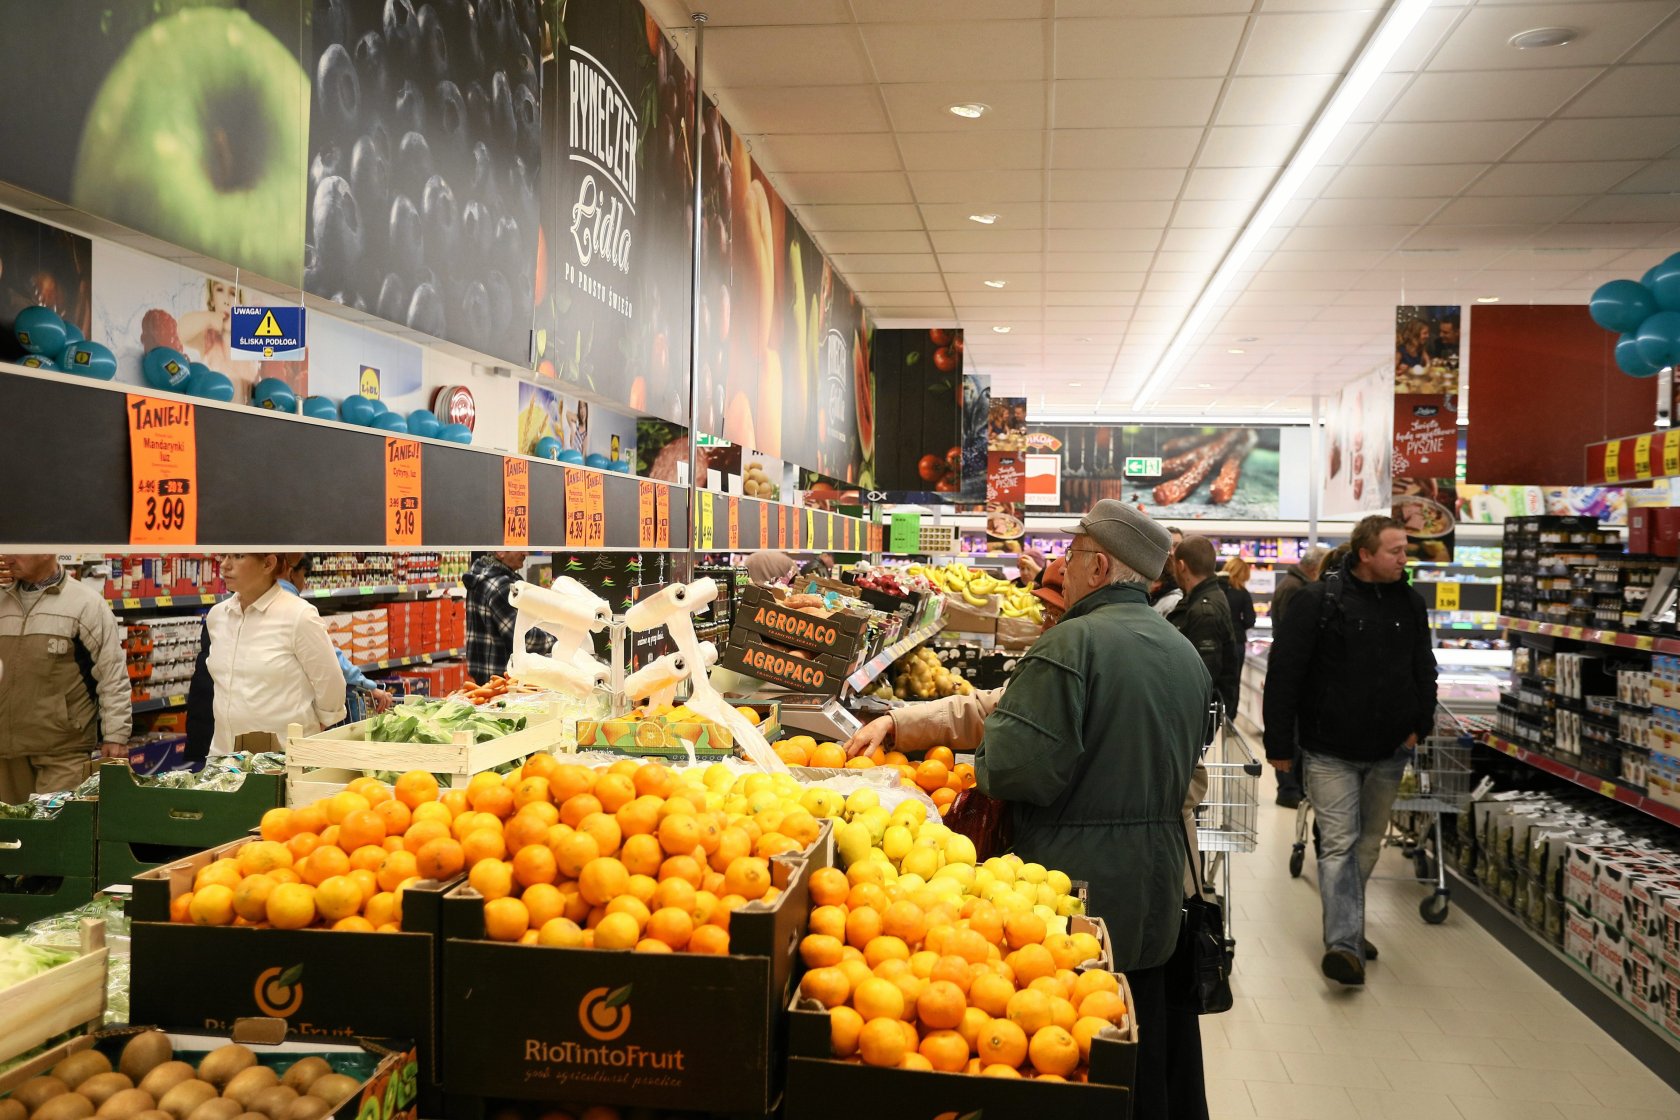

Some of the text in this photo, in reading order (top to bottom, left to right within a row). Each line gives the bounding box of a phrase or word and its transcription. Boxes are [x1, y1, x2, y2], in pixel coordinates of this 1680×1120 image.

[569, 58, 638, 205] RYNECZEK
[570, 174, 632, 275] Lidla
[565, 262, 575, 284] PO
[578, 270, 606, 303] PROSTO
[233, 307, 262, 315] UWAGA!
[239, 336, 297, 346] ŚLISKA PODŁOGA
[131, 399, 190, 431] TANIEJ!
[143, 437, 185, 453] Mandarynki
[388, 440, 420, 463] TANIEJ!
[1406, 437, 1444, 456] PYSZNE
[505, 458, 527, 477] TANIEJ!
[144, 496, 185, 531] 3.99
[394, 510, 415, 535] 3.19
[507, 516, 527, 538] 14.39
[569, 520, 583, 540] 4.39
[589, 522, 602, 540] 2.79
[754, 607, 838, 647] AGROPACO
[742, 648, 825, 688] AGROPACO
[524, 1039, 685, 1071] RioTintoFruit
